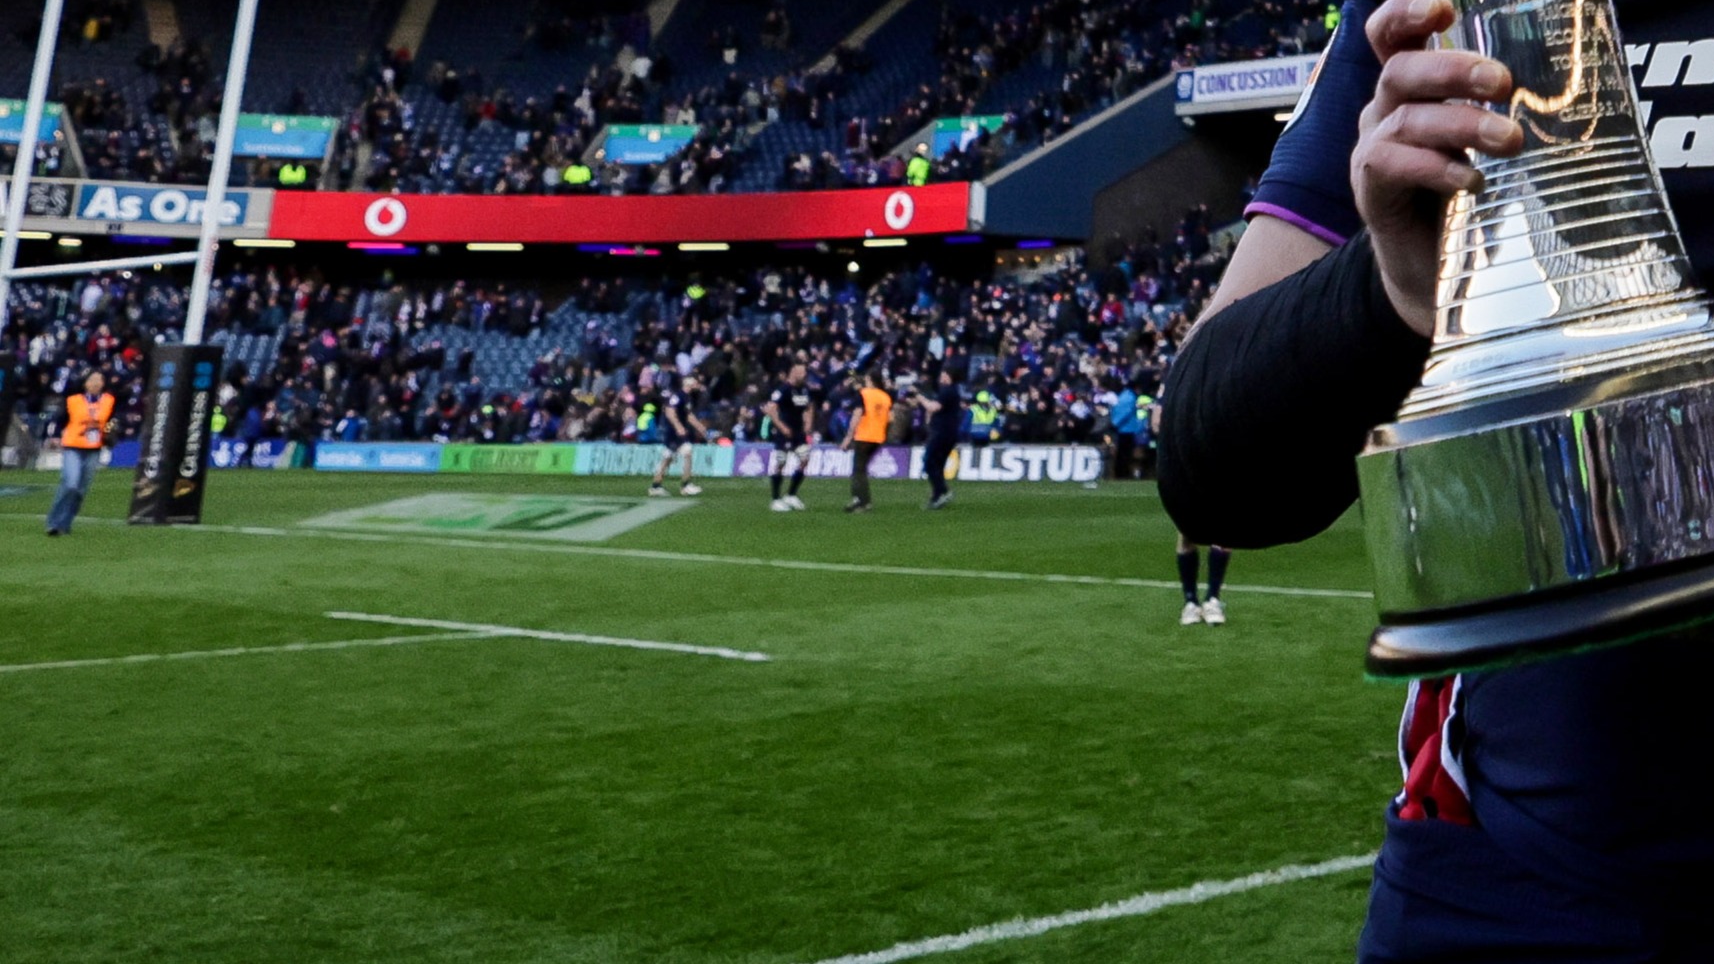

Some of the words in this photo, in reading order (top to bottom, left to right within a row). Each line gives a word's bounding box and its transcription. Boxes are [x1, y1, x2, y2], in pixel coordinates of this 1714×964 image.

[1197, 66, 1298, 95] CONCUSSION
[82, 186, 144, 220] As
[149, 189, 242, 225] One
